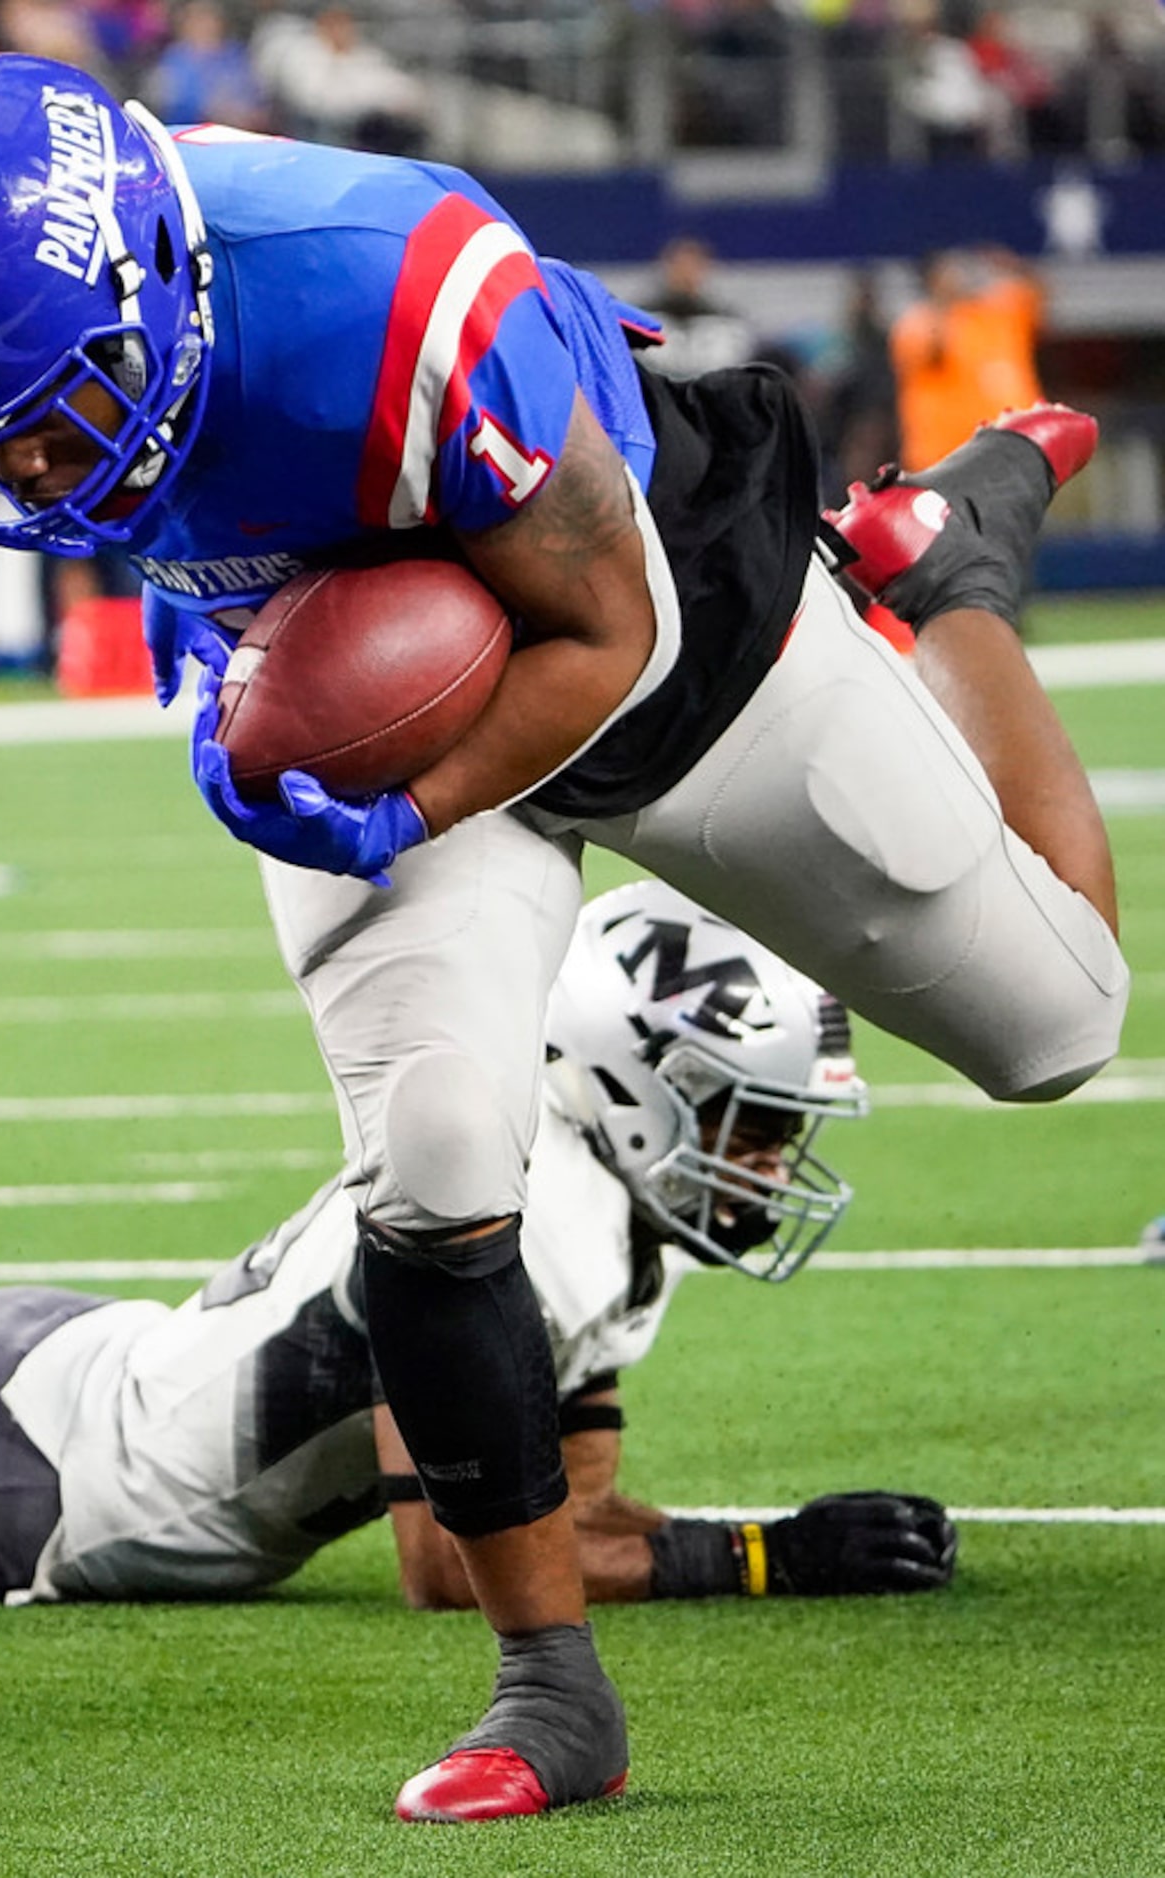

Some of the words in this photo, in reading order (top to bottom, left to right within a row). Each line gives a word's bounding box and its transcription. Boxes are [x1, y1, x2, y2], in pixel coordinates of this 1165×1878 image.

[34, 84, 105, 281] PANTHERS
[468, 408, 554, 507] 1
[615, 917, 775, 1041] M
